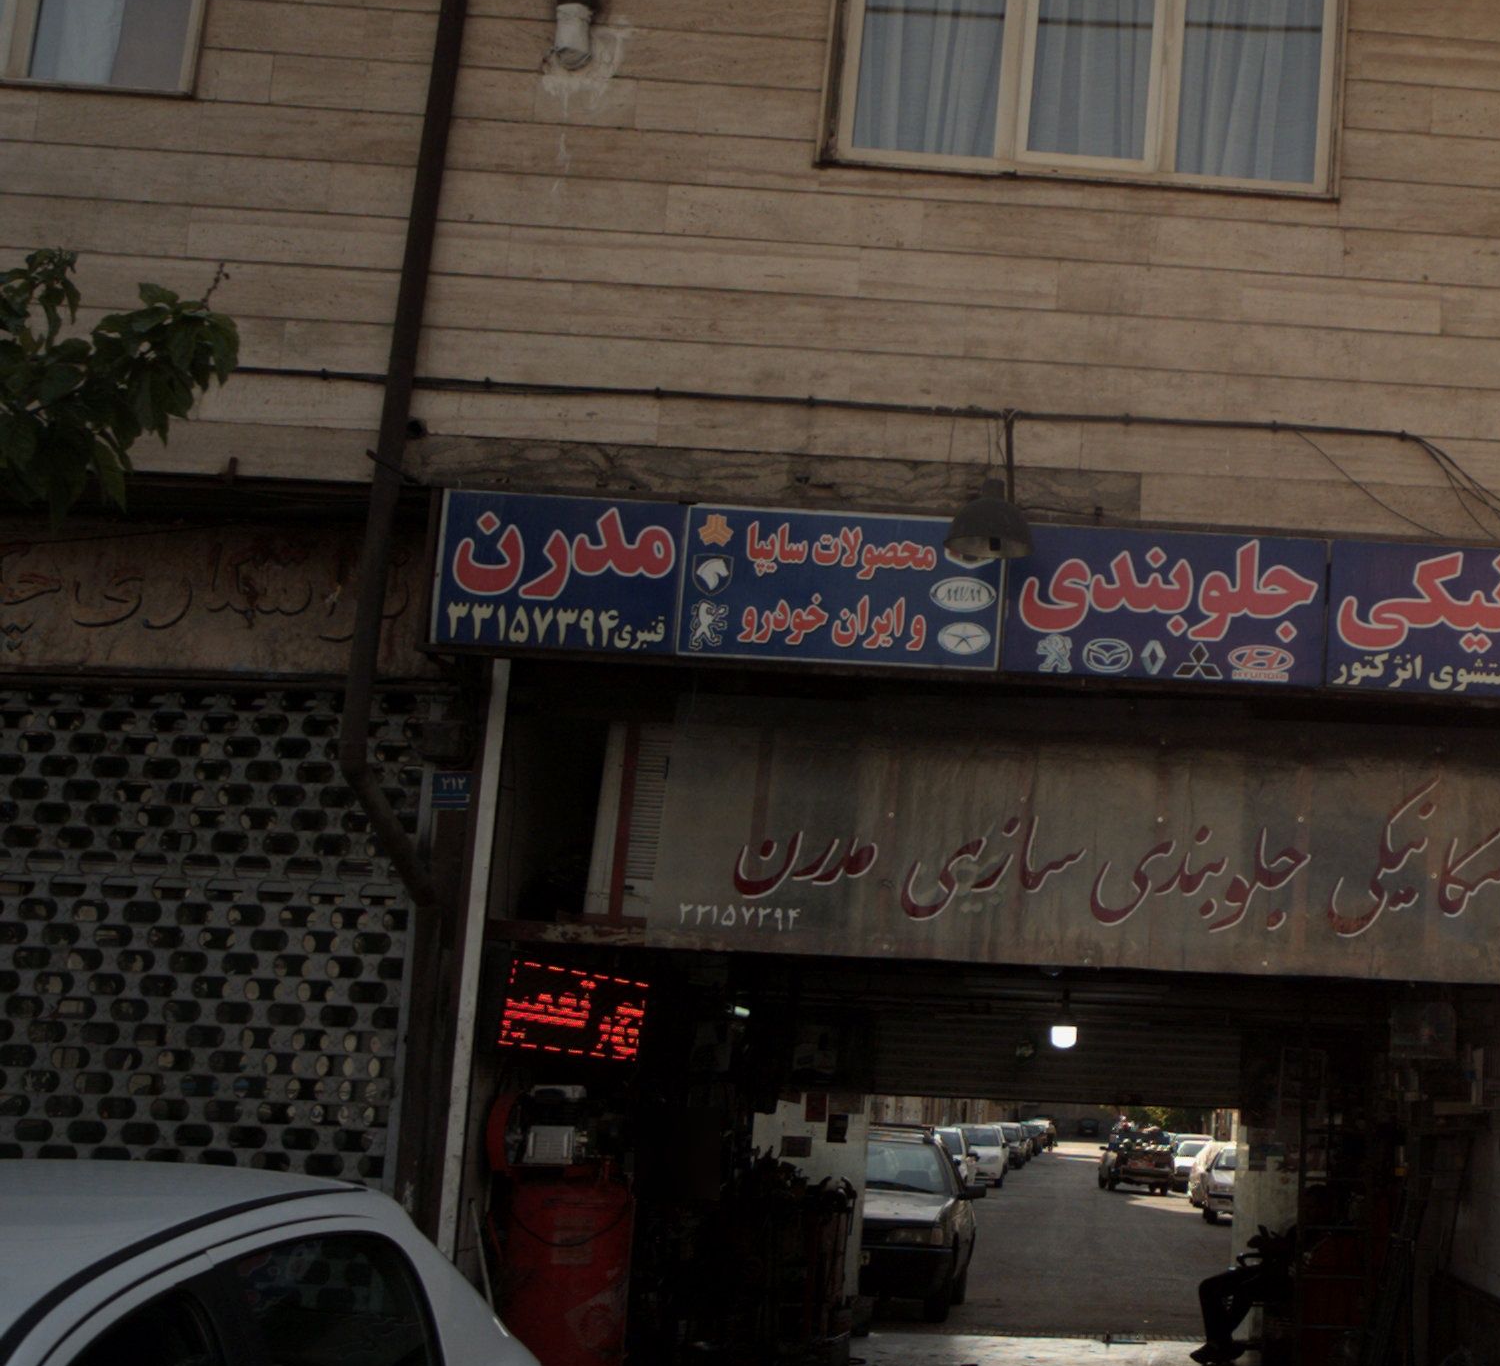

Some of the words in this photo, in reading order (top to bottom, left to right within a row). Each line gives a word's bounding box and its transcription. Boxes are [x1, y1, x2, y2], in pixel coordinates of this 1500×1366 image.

[453, 507, 675, 600] مدرن
[747, 520, 808, 577] سایپا
[813, 526, 937, 579] محصولات
[447, 602, 620, 647] ۳۳۱۵۷۳۹۴
[614, 616, 665, 650] قنبری
[737, 592, 829, 646] خودرو
[832, 594, 905, 649] ایران
[906, 614, 927, 651] و
[733, 831, 879, 899] مدرن
